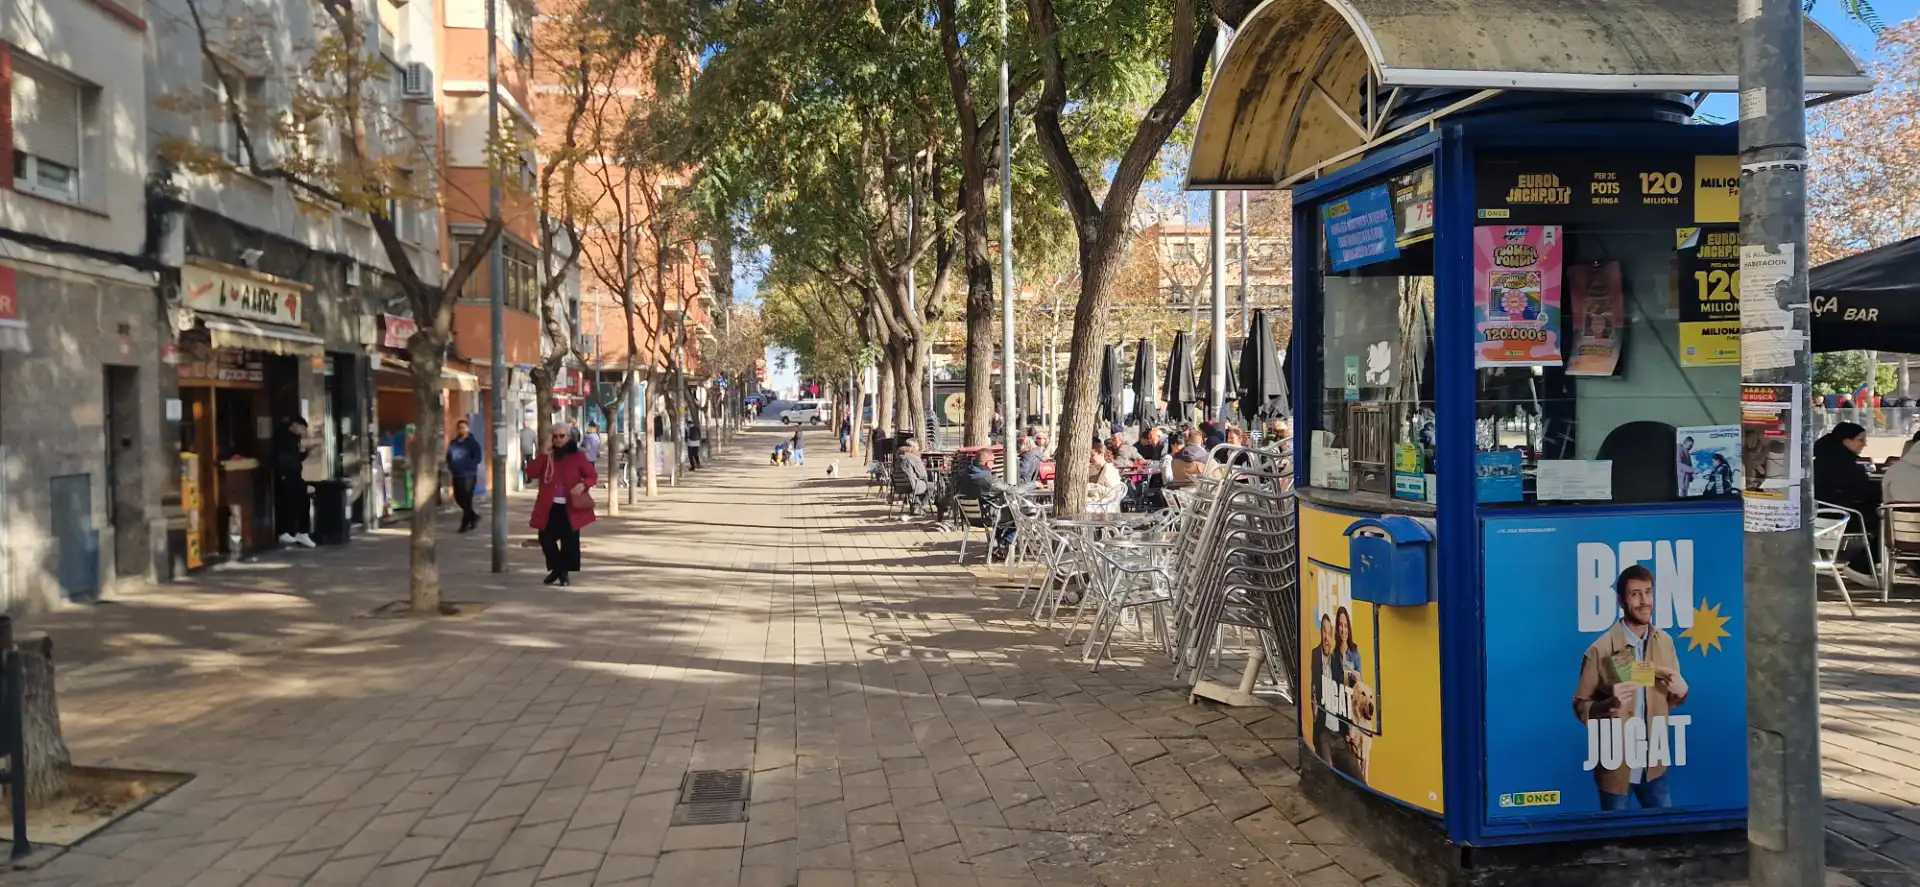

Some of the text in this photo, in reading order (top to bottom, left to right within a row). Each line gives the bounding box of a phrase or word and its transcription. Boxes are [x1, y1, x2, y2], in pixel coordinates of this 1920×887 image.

[1518, 173, 1553, 188] EURO
[1639, 172, 1683, 195] 120
[1591, 182, 1620, 194] POTS
[1505, 187, 1568, 204] JACKPOT
[1643, 197, 1679, 205] MILIONS
[1708, 233, 1738, 245] EURO
[1697, 245, 1740, 258] JACKPO
[1701, 302, 1740, 312] MILION
[1809, 296, 1879, 322] ÇA BAR
[1484, 328, 1547, 342] 120.000€
[1702, 327, 1740, 336] MILIONA
[1321, 674, 1354, 720] JUGAT
[1582, 714, 1692, 772] JUGAT
[1526, 792, 1558, 804] ONCE
